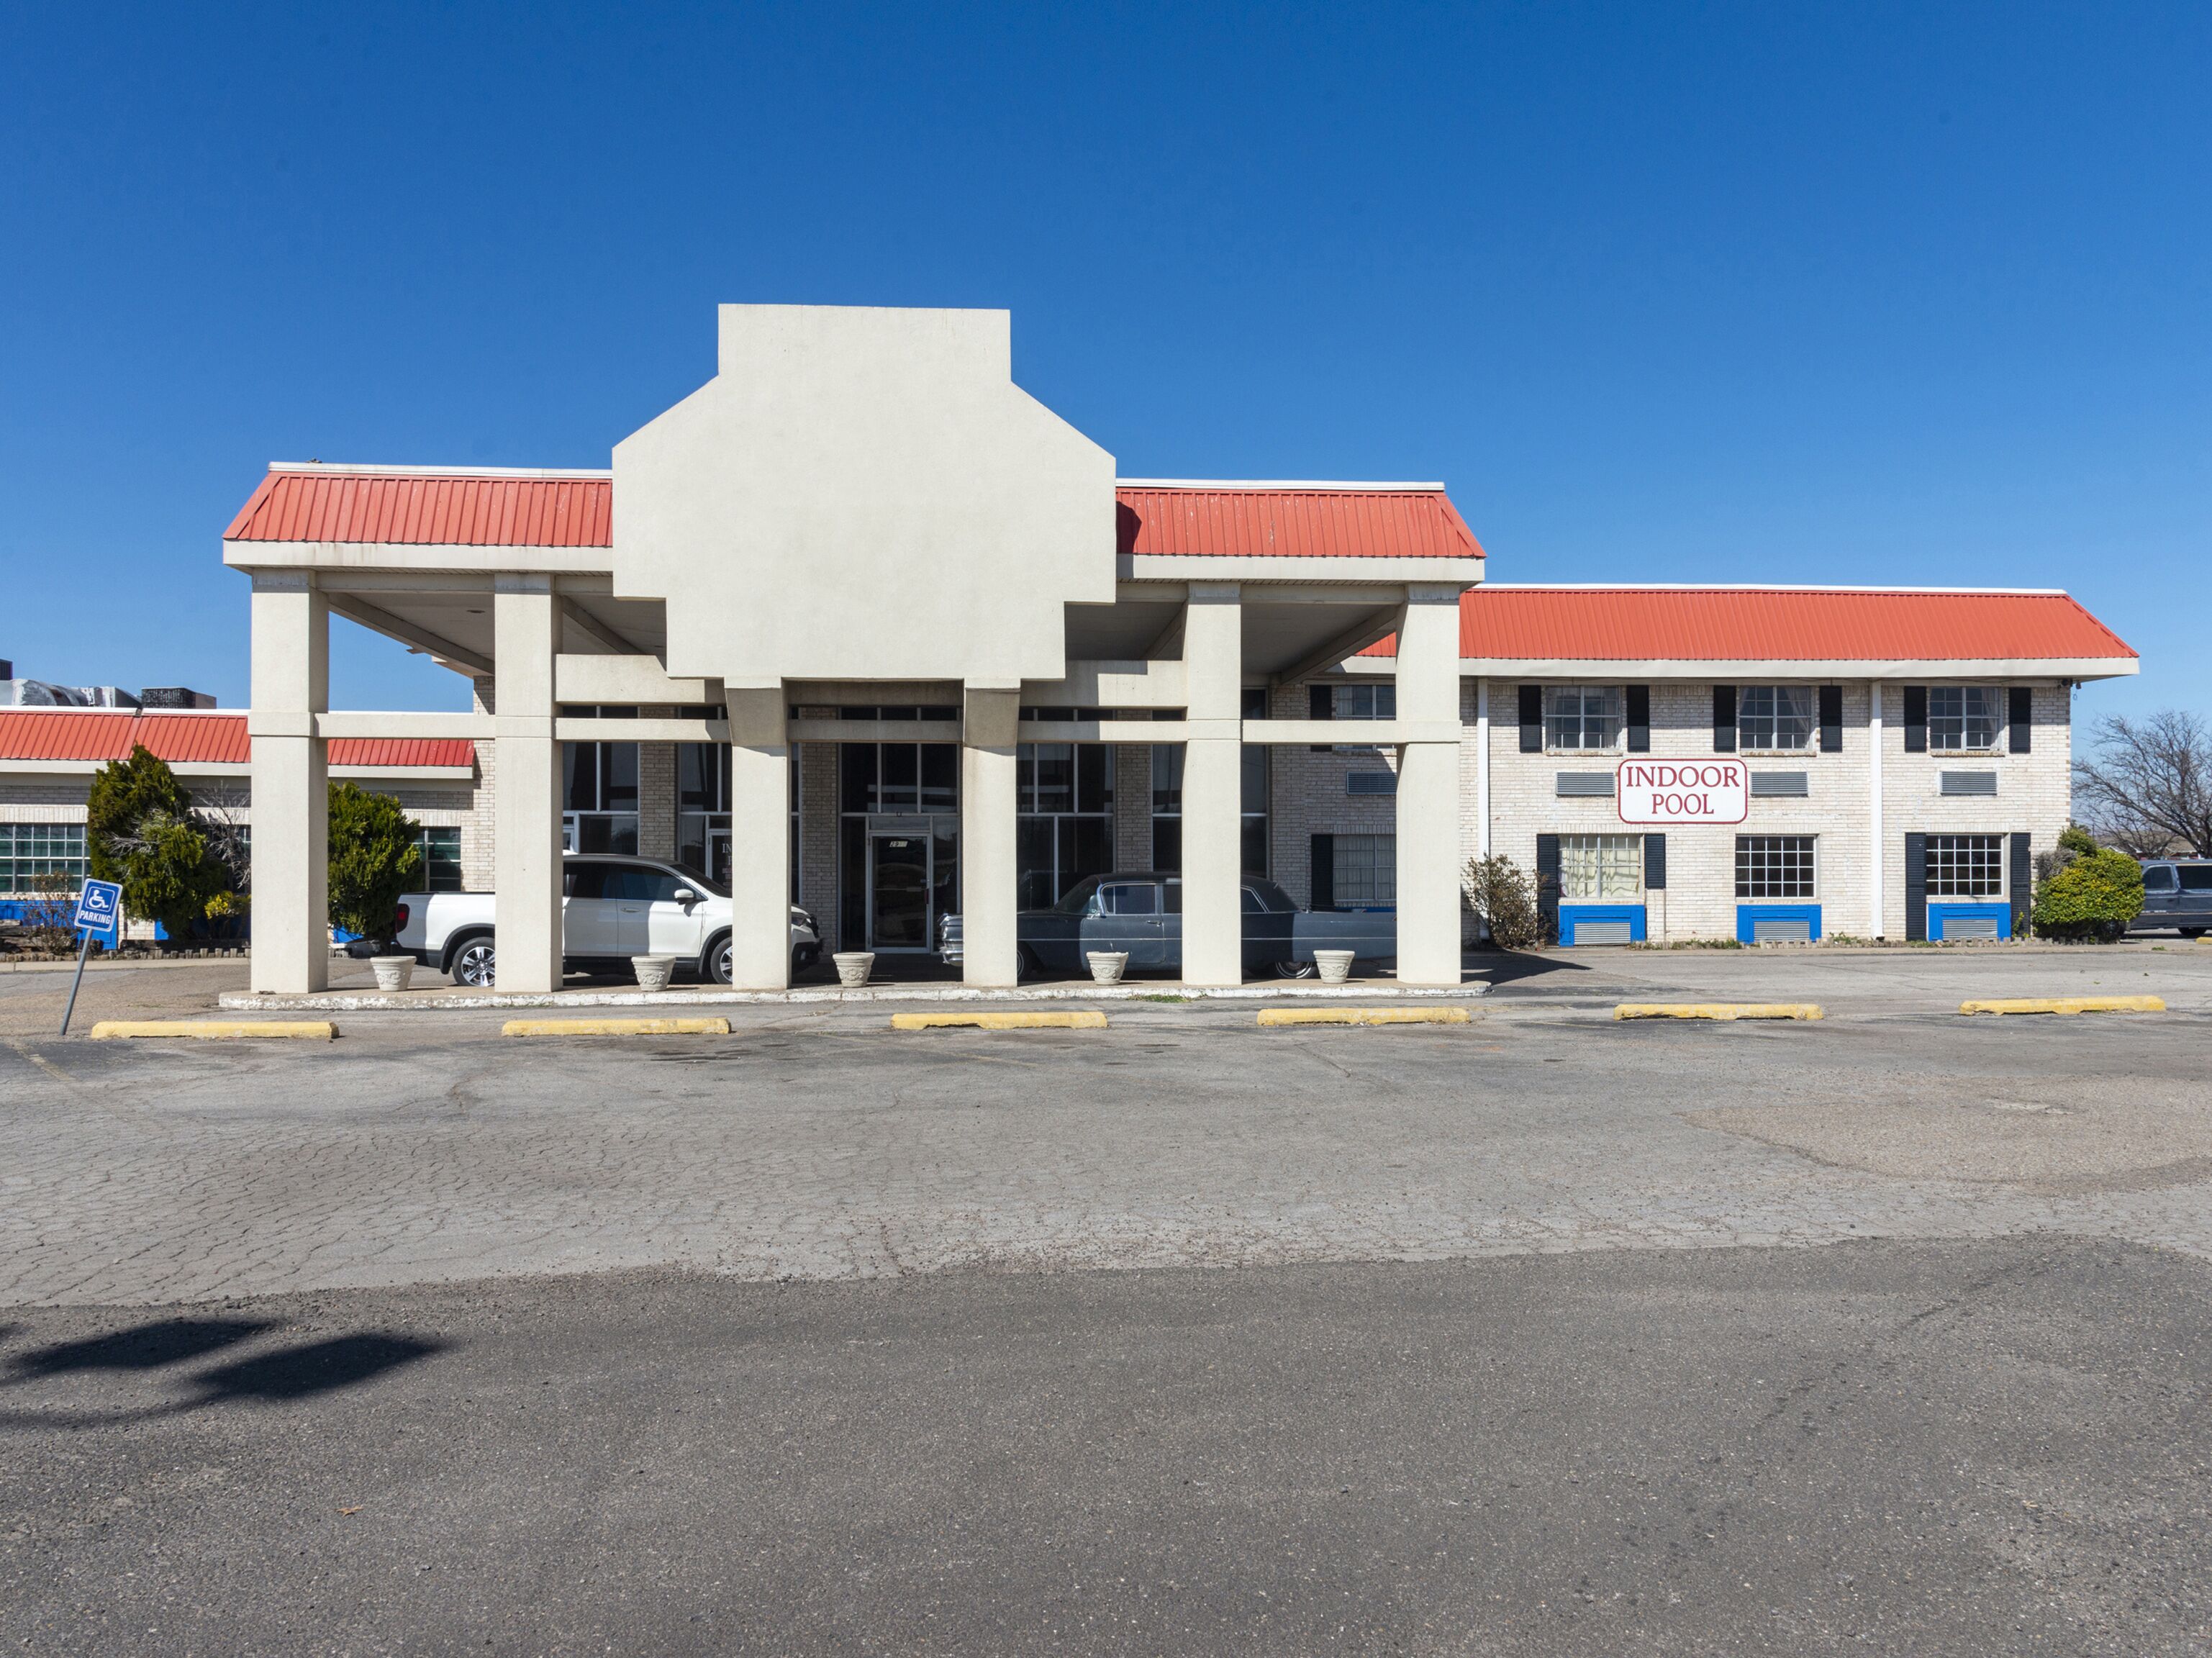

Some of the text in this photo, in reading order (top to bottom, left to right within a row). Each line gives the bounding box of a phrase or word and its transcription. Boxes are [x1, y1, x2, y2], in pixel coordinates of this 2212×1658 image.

[1626, 766, 1740, 787] INDOOR
[1651, 793, 1714, 815] POOL
[79, 910, 112, 925] PARKING
